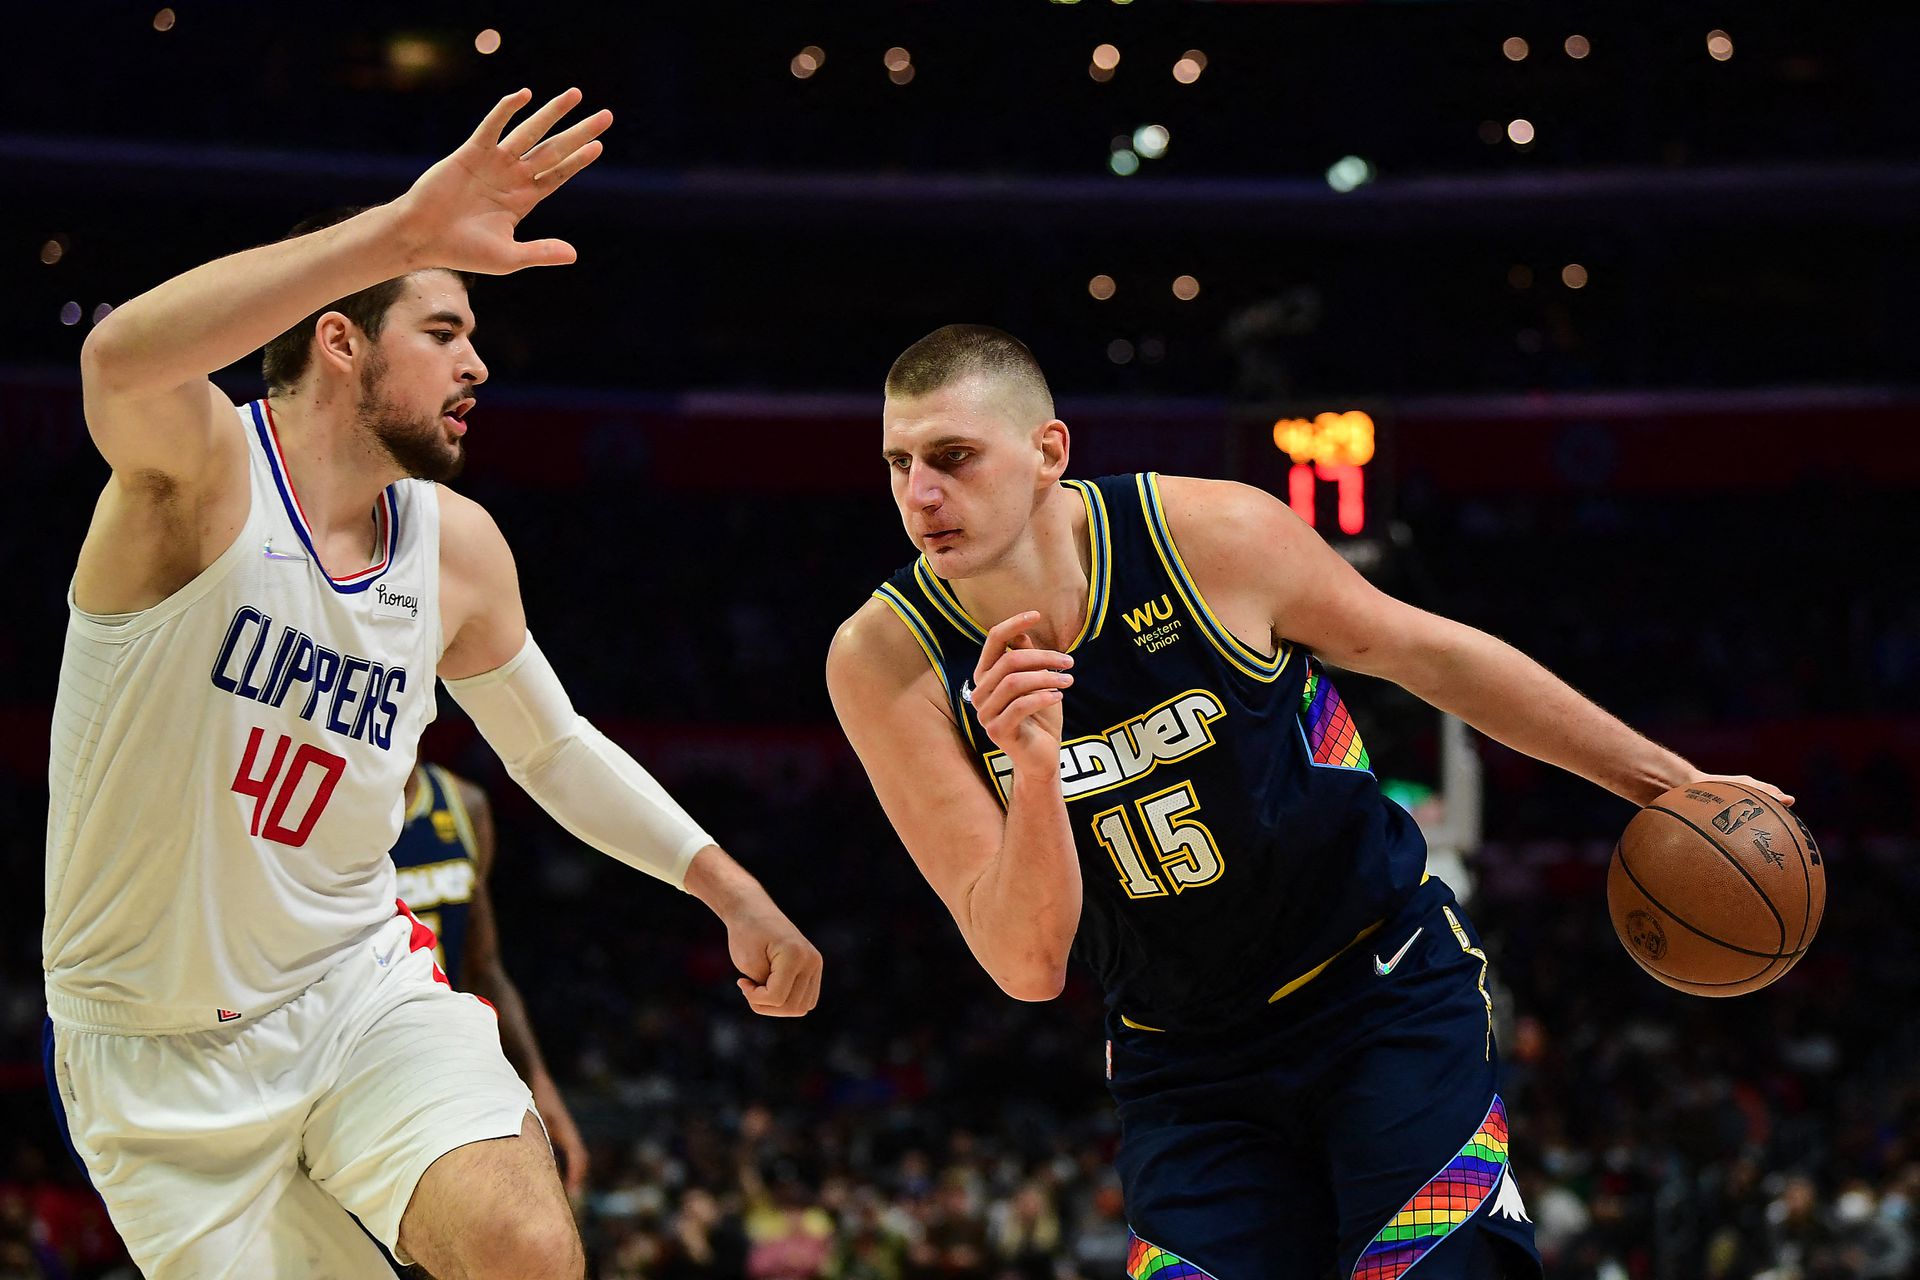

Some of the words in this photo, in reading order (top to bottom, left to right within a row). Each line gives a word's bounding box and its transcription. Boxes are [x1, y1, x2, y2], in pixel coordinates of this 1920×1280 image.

[375, 584, 418, 617] honey
[1122, 594, 1173, 633] WU
[1133, 620, 1182, 647] Western
[1146, 633, 1180, 653] Union
[211, 605, 406, 751] CLIPPERS
[231, 727, 346, 847] 40
[1091, 780, 1225, 899] 15
